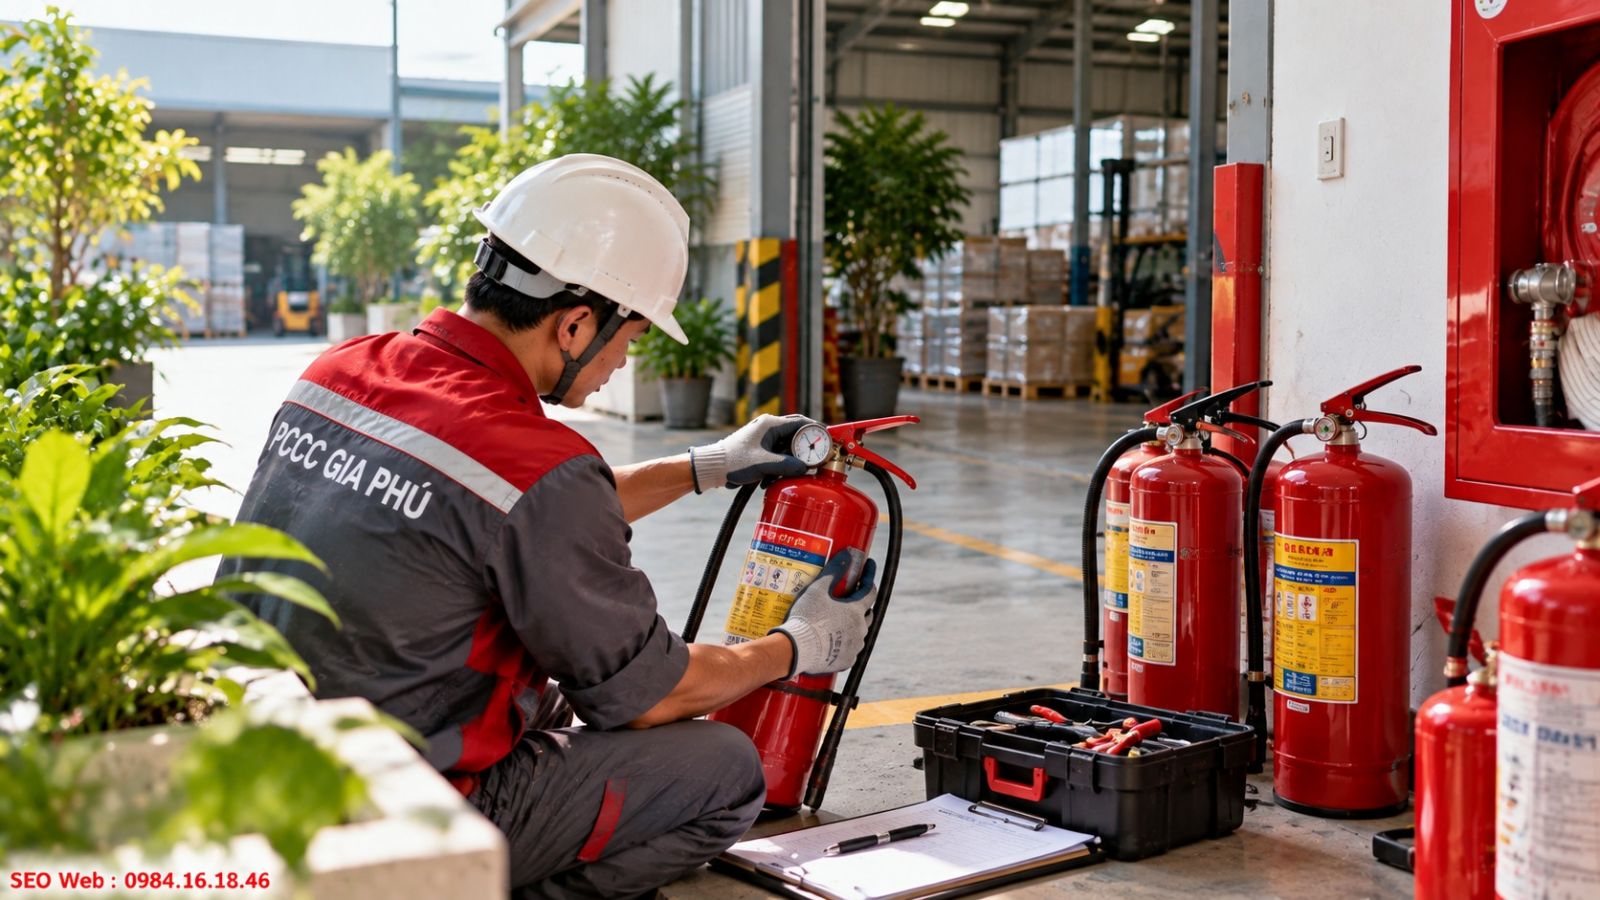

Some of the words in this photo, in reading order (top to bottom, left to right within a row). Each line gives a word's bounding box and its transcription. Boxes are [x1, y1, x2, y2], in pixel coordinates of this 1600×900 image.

[268, 421, 327, 469] PCCC
[323, 448, 367, 491] GIA
[364, 466, 433, 519] PHÚ
